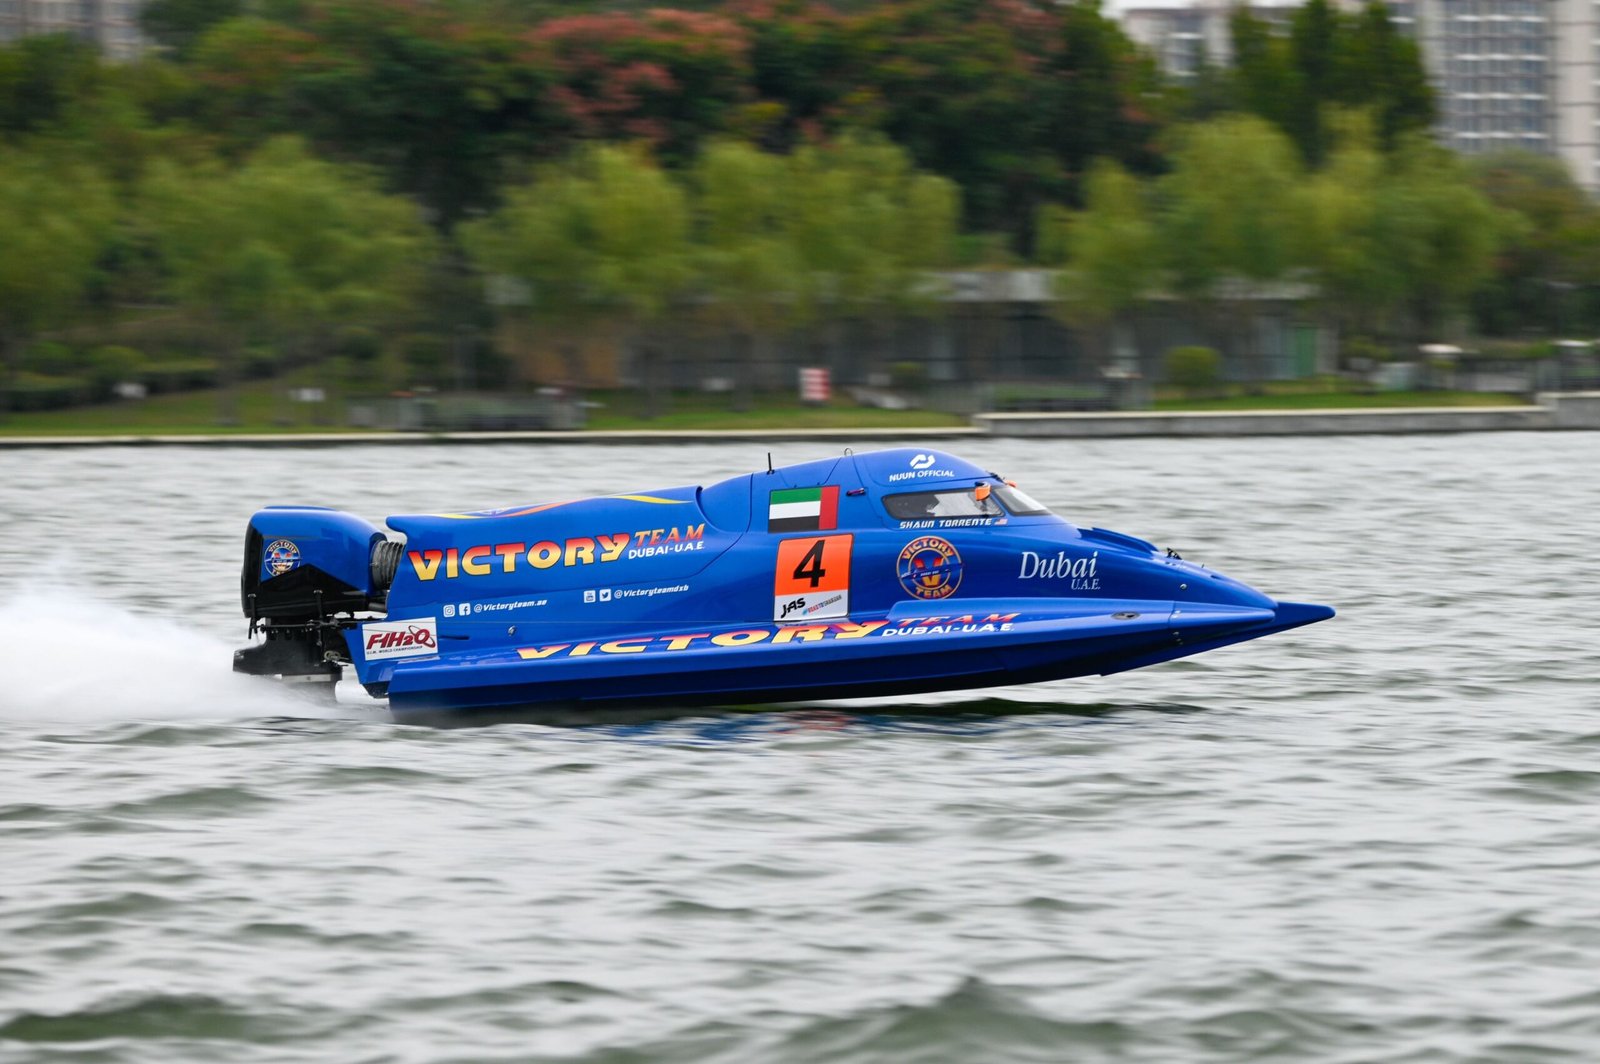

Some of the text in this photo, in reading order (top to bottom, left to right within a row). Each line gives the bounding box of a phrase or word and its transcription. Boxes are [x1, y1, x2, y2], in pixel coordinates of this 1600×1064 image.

[889, 470, 955, 482] NUUN OFFICIAL
[900, 518, 992, 529] SHAUN TORRENTE
[634, 523, 705, 547] TEAM
[408, 533, 630, 581] VICTORY
[901, 537, 956, 560] VICTORY
[792, 540, 826, 588] 4
[1018, 551, 1098, 579] Dubai
[614, 584, 689, 599] @Victoryteamdxb
[916, 584, 953, 598] TEAM
[1071, 578, 1101, 590] U.A.E.
[473, 599, 548, 614] @Victoryteam.ae
[781, 597, 806, 619] JAS
[898, 612, 1021, 627] TEAM
[516, 620, 891, 660] VICTORY
